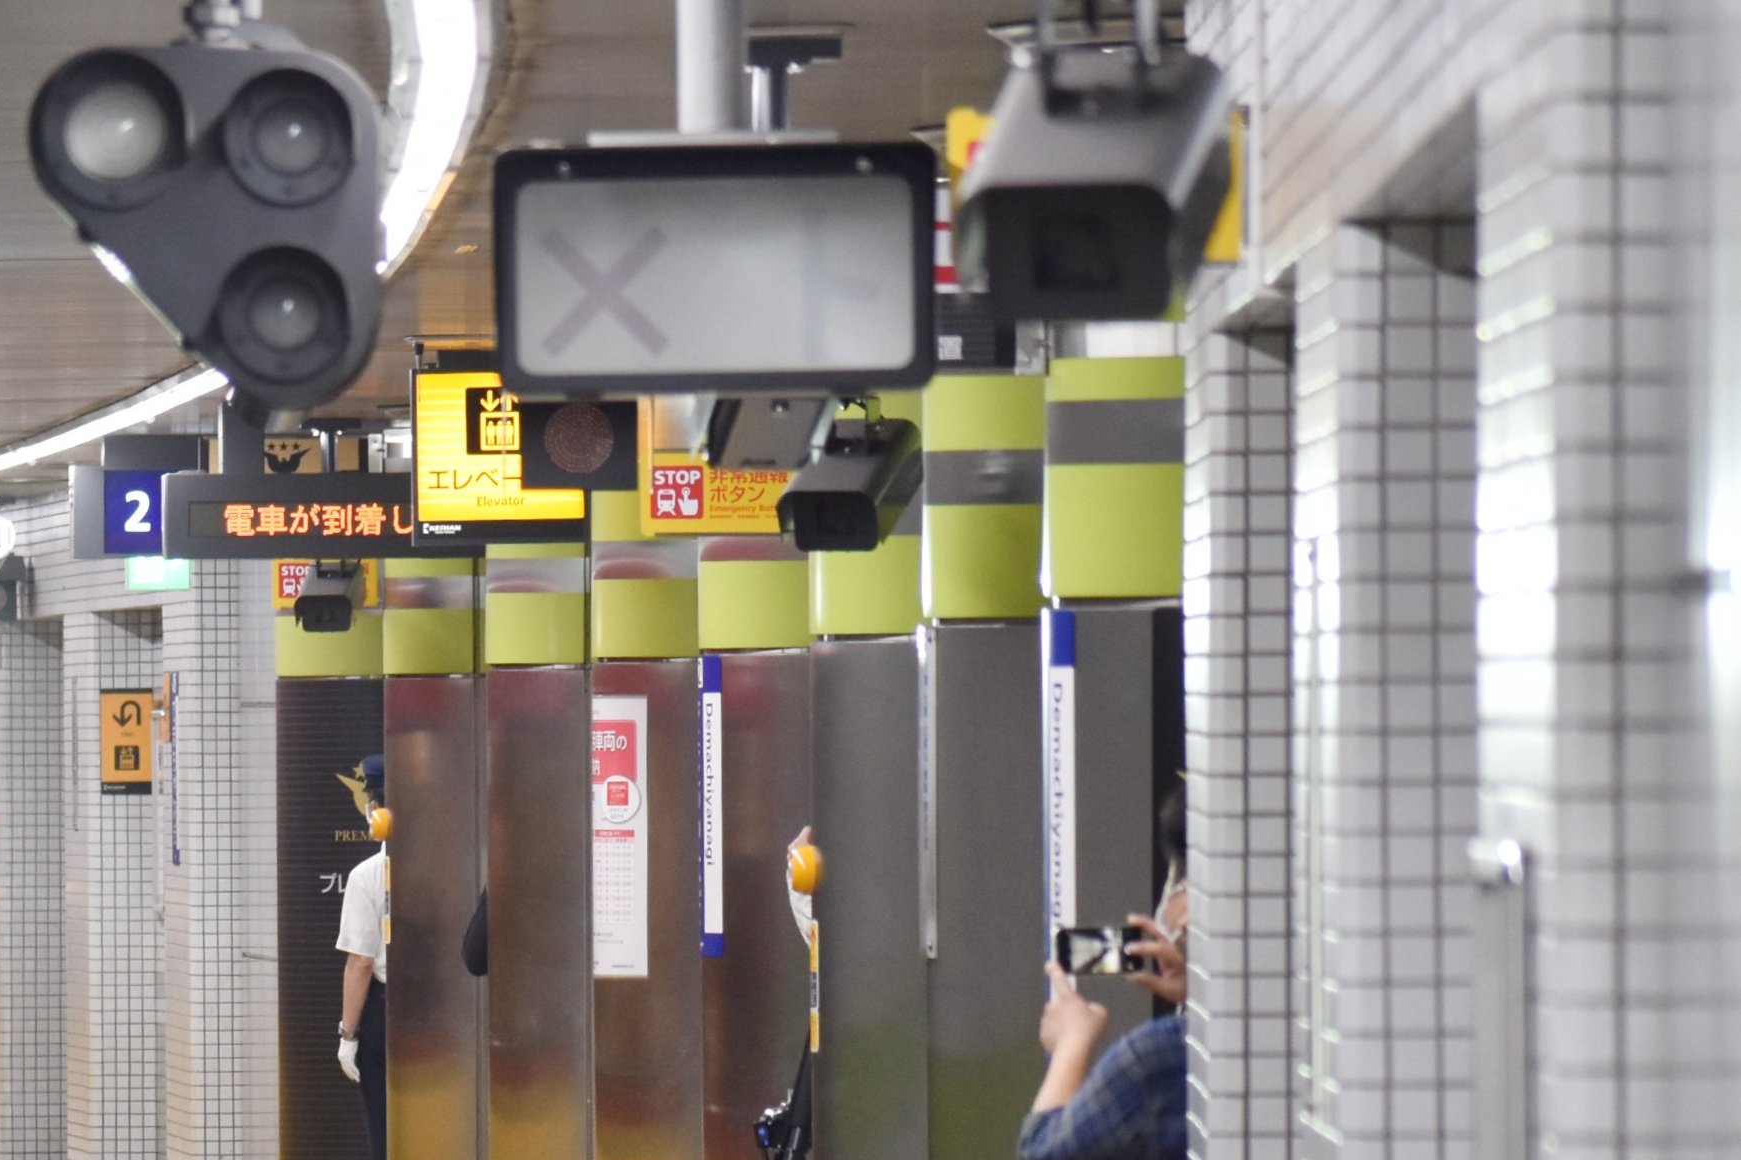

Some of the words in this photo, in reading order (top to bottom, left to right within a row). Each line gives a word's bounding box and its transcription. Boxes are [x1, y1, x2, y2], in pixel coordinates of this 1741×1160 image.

[429, 469, 522, 490] エレベー
[654, 470, 701, 485] STOP
[477, 496, 526, 507] Elevator
[710, 485, 766, 503] ボタン
[123, 490, 152, 533] 2
[710, 504, 757, 513] Emergency
[224, 503, 412, 536] 電車が到着し
[705, 703, 715, 866] Demachiyanagi
